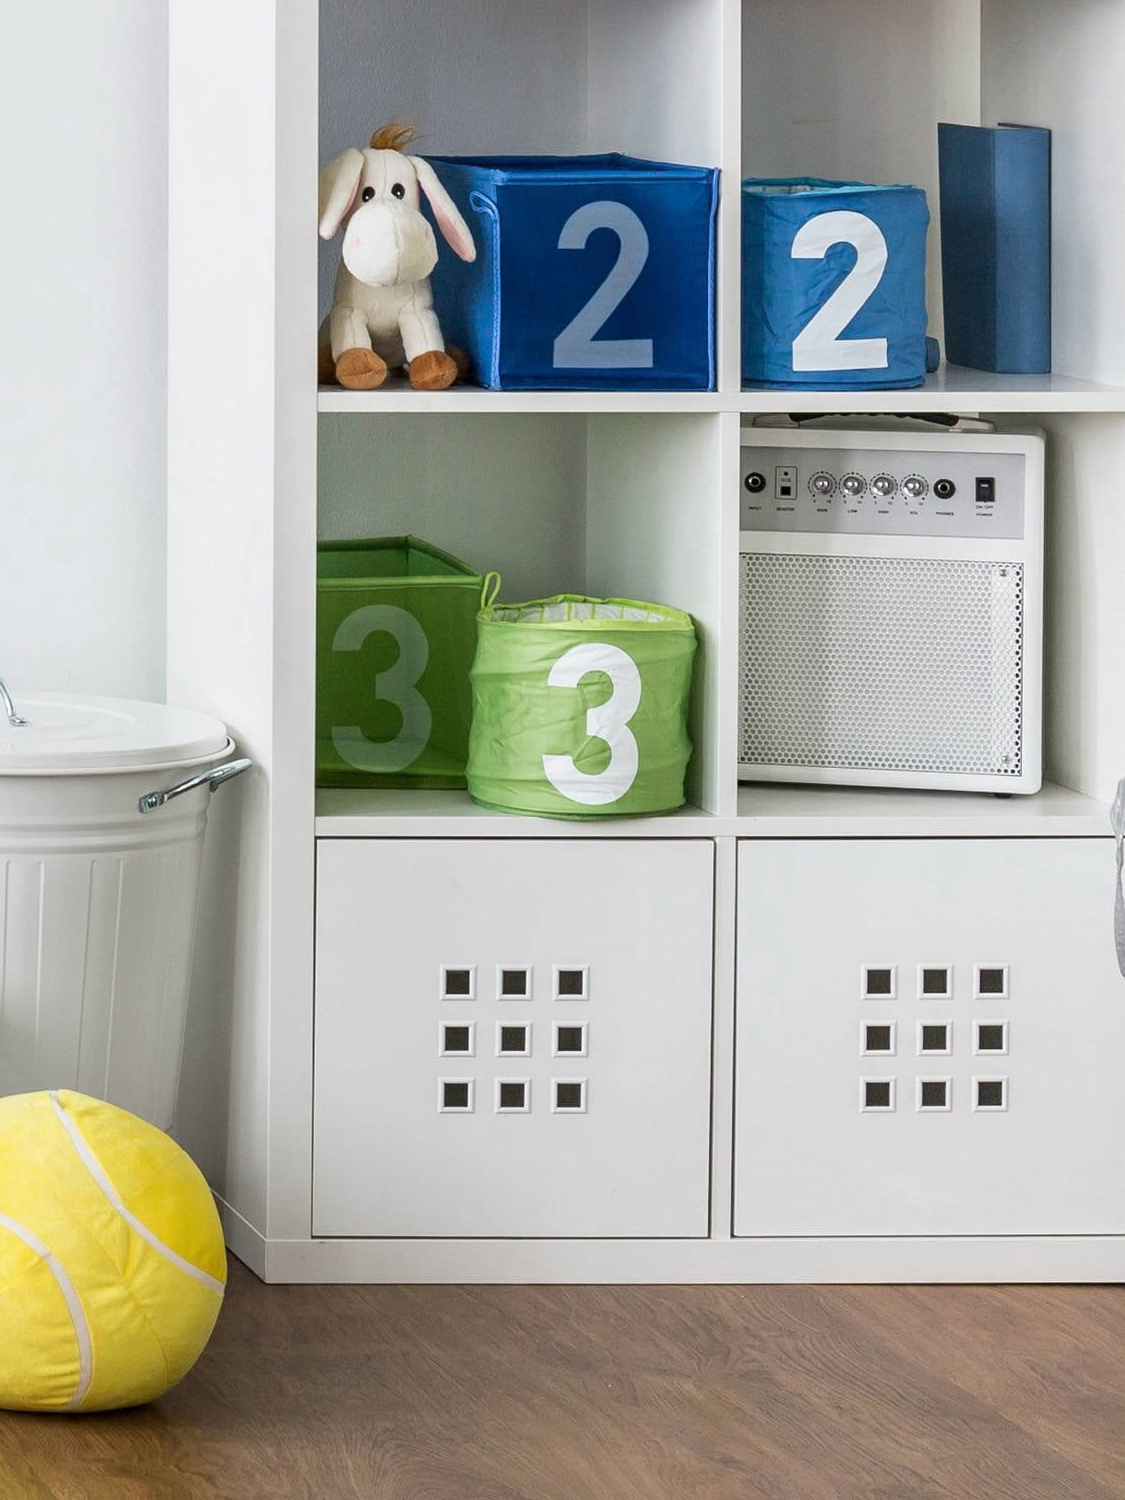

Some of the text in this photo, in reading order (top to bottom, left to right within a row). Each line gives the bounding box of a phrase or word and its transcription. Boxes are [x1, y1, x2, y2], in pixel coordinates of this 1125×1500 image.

[552, 201, 654, 369] 2
[790, 210, 889, 372] 2
[331, 604, 432, 774] 3
[541, 643, 642, 806] 3
